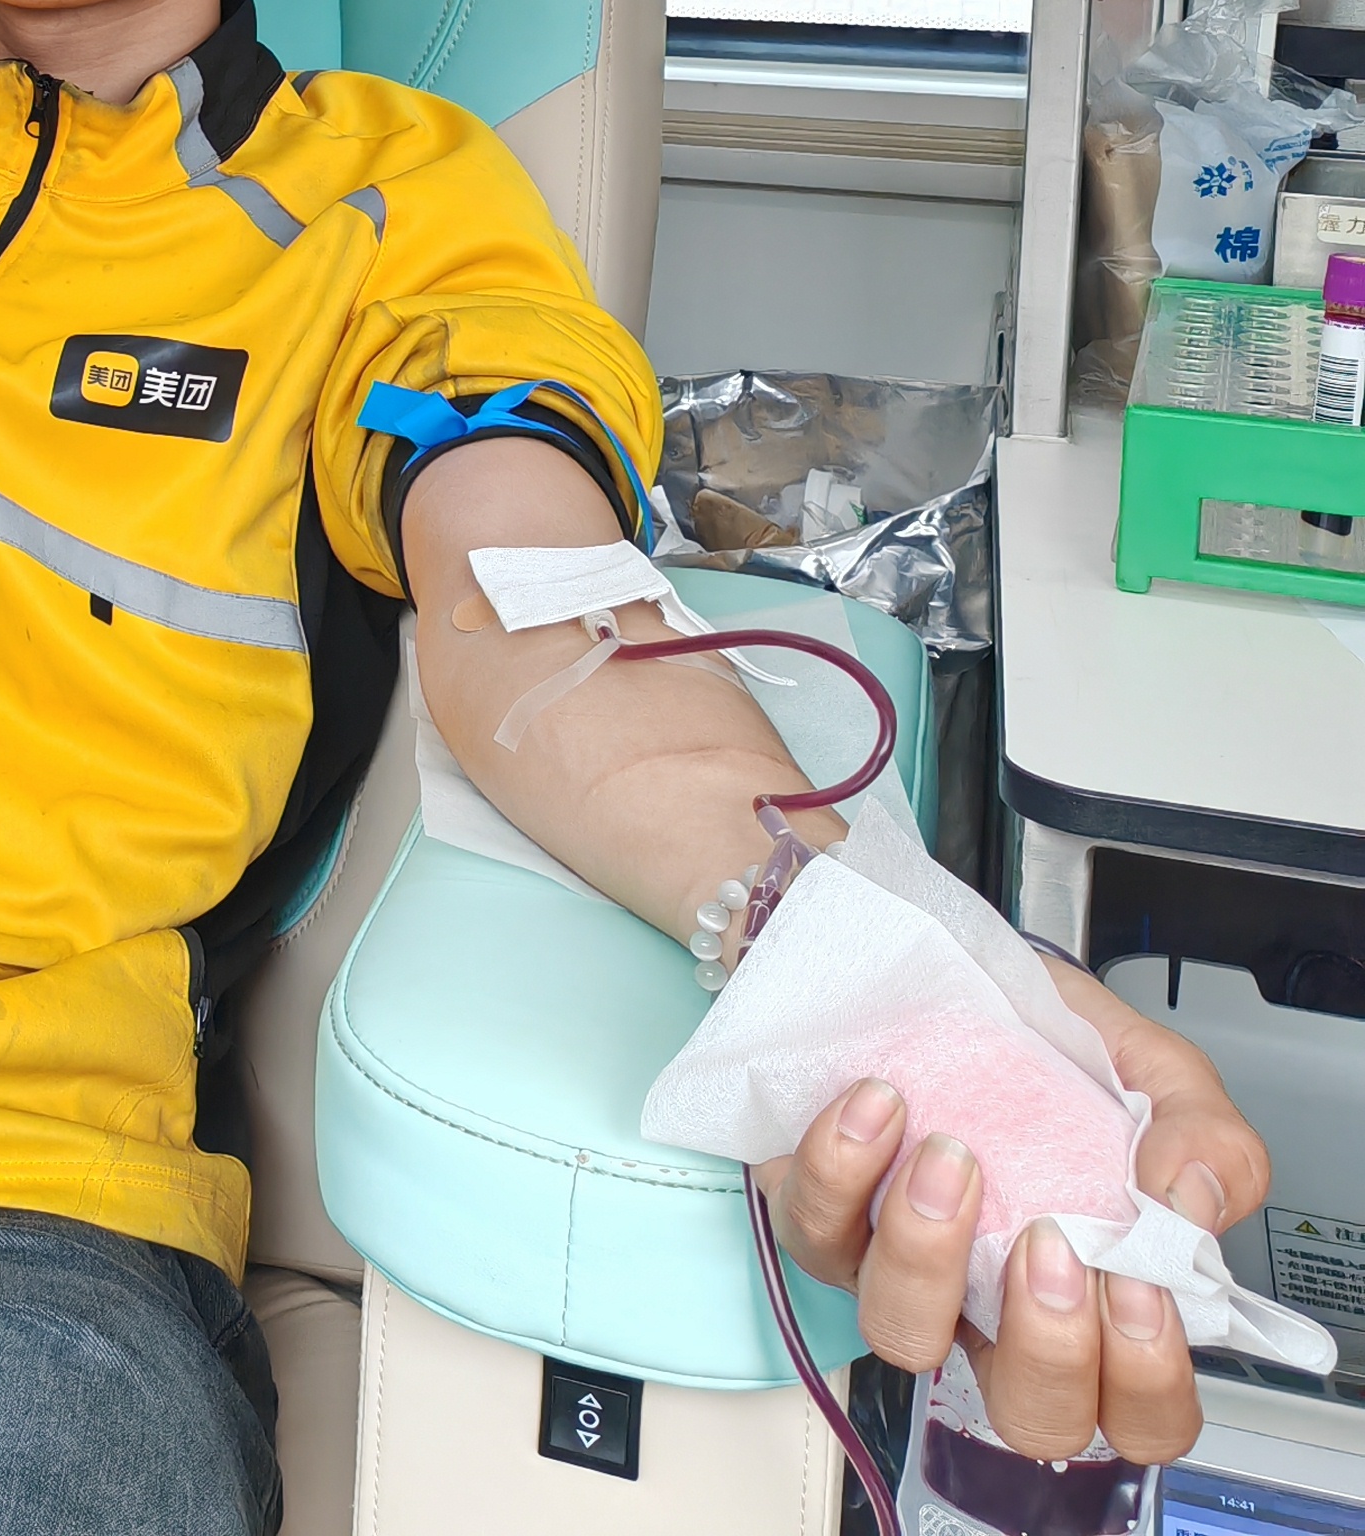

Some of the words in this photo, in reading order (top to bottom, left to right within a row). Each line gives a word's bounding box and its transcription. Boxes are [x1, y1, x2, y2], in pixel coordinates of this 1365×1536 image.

[1214, 226, 1261, 264] 棉
[86, 365, 133, 392] 美团
[138, 366, 218, 411] 美团
[1219, 1495, 1255, 1514] 14:41
